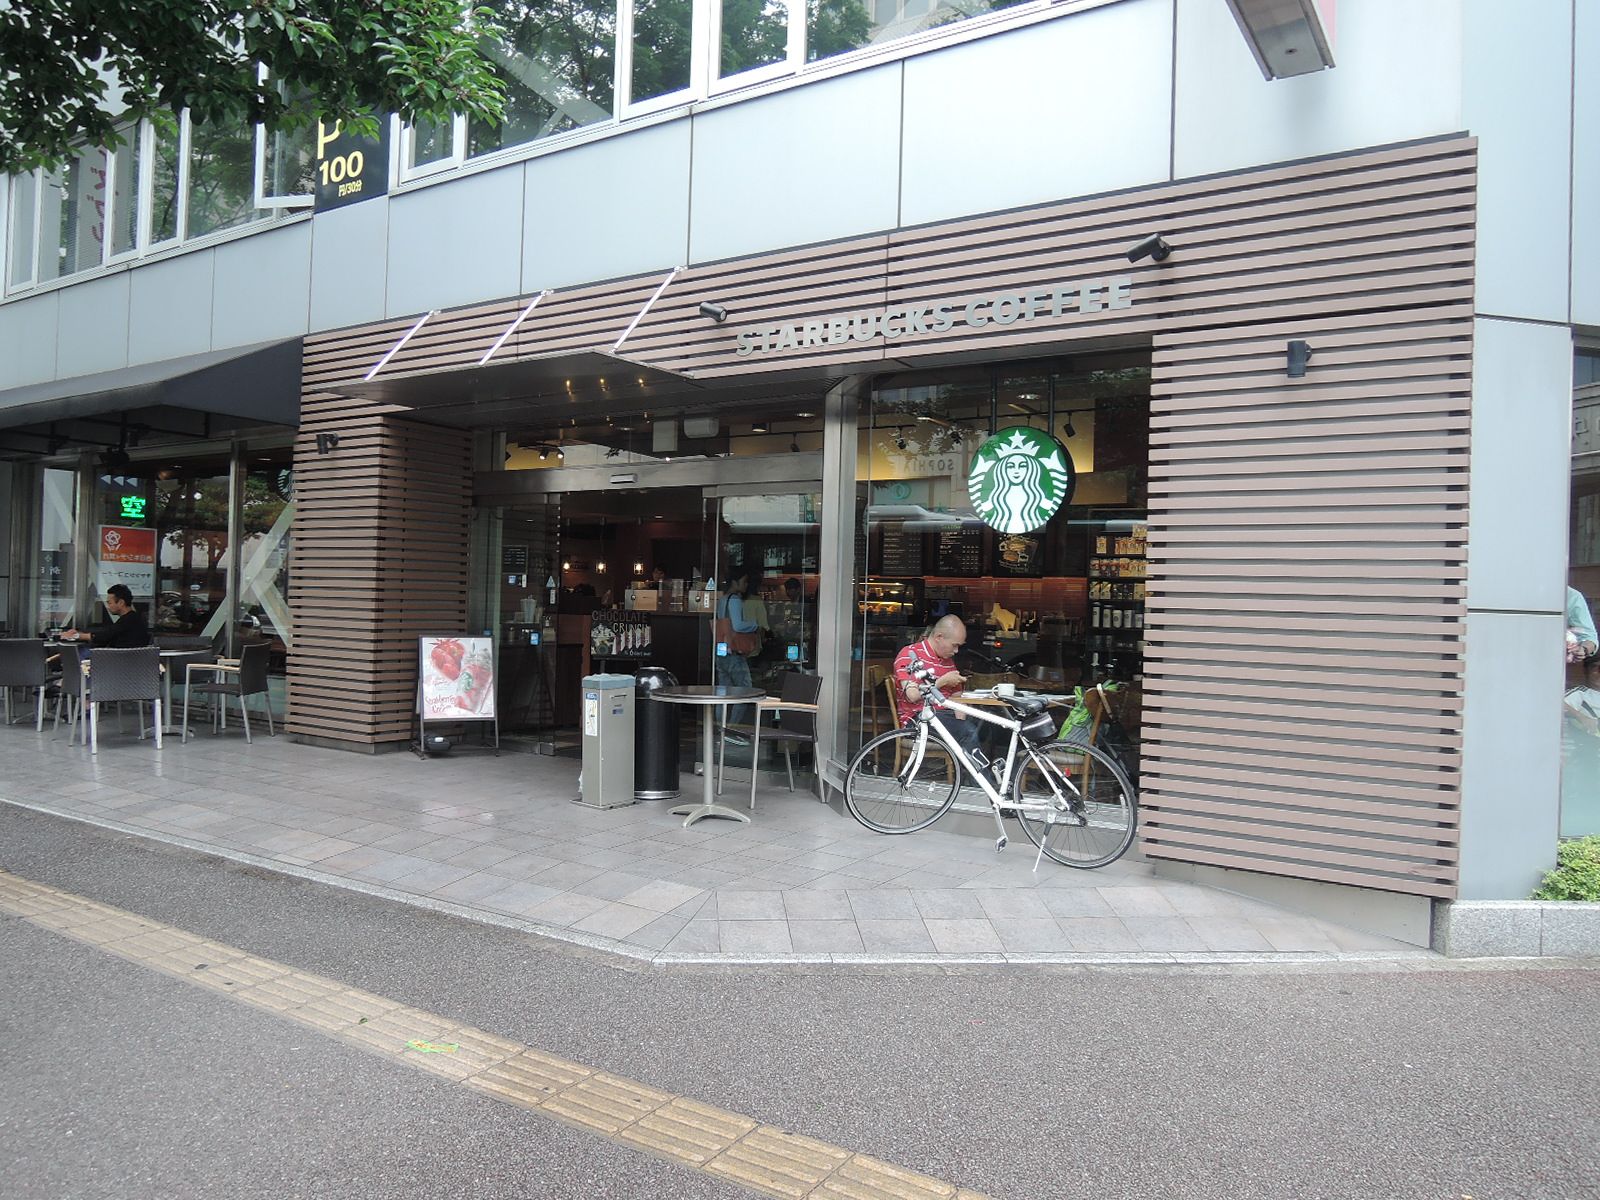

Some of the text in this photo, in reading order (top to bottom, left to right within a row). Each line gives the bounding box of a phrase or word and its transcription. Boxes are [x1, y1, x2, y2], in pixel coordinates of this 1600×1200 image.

[319, 151, 364, 186] 100
[735, 277, 1132, 357] STARBUCKS COFFEE
[591, 608, 649, 623] CHOCOLATE
